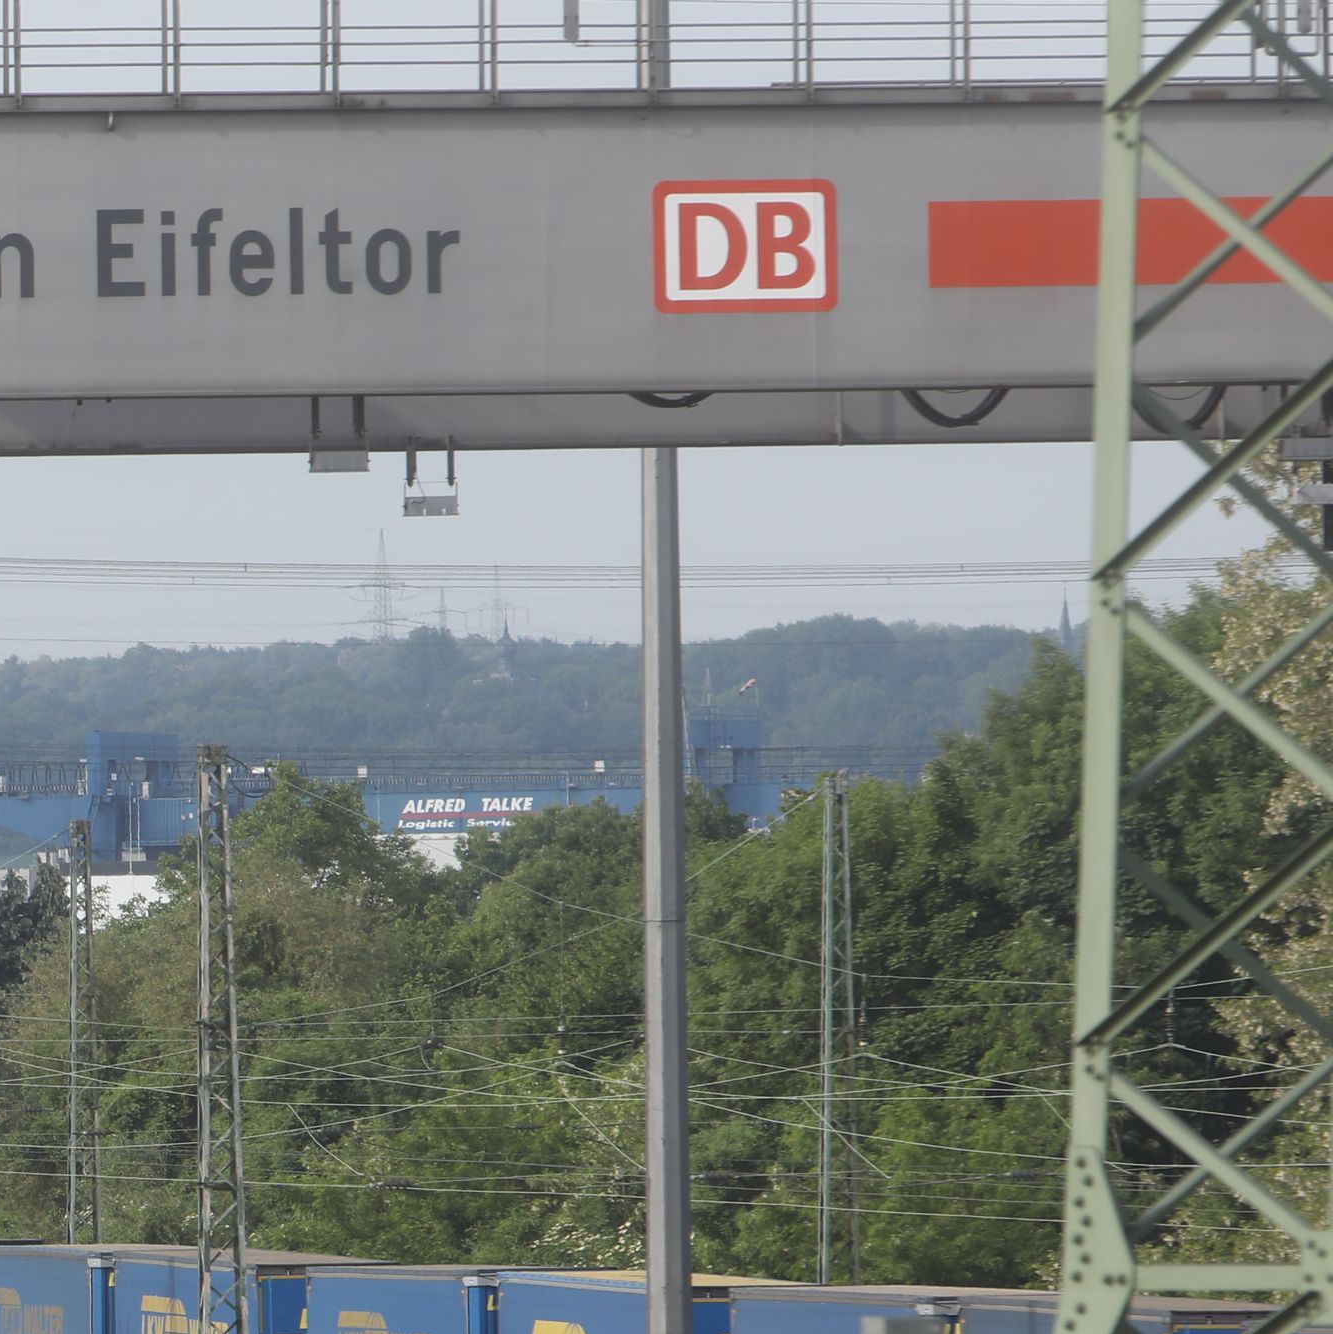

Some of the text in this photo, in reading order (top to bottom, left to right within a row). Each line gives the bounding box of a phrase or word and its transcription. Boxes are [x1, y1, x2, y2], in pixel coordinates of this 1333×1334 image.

[95, 206, 462, 300] Eifeltor
[678, 201, 816, 290] DB
[397, 817, 456, 831] Logistic
[401, 796, 534, 814] ALFRED TALKE
